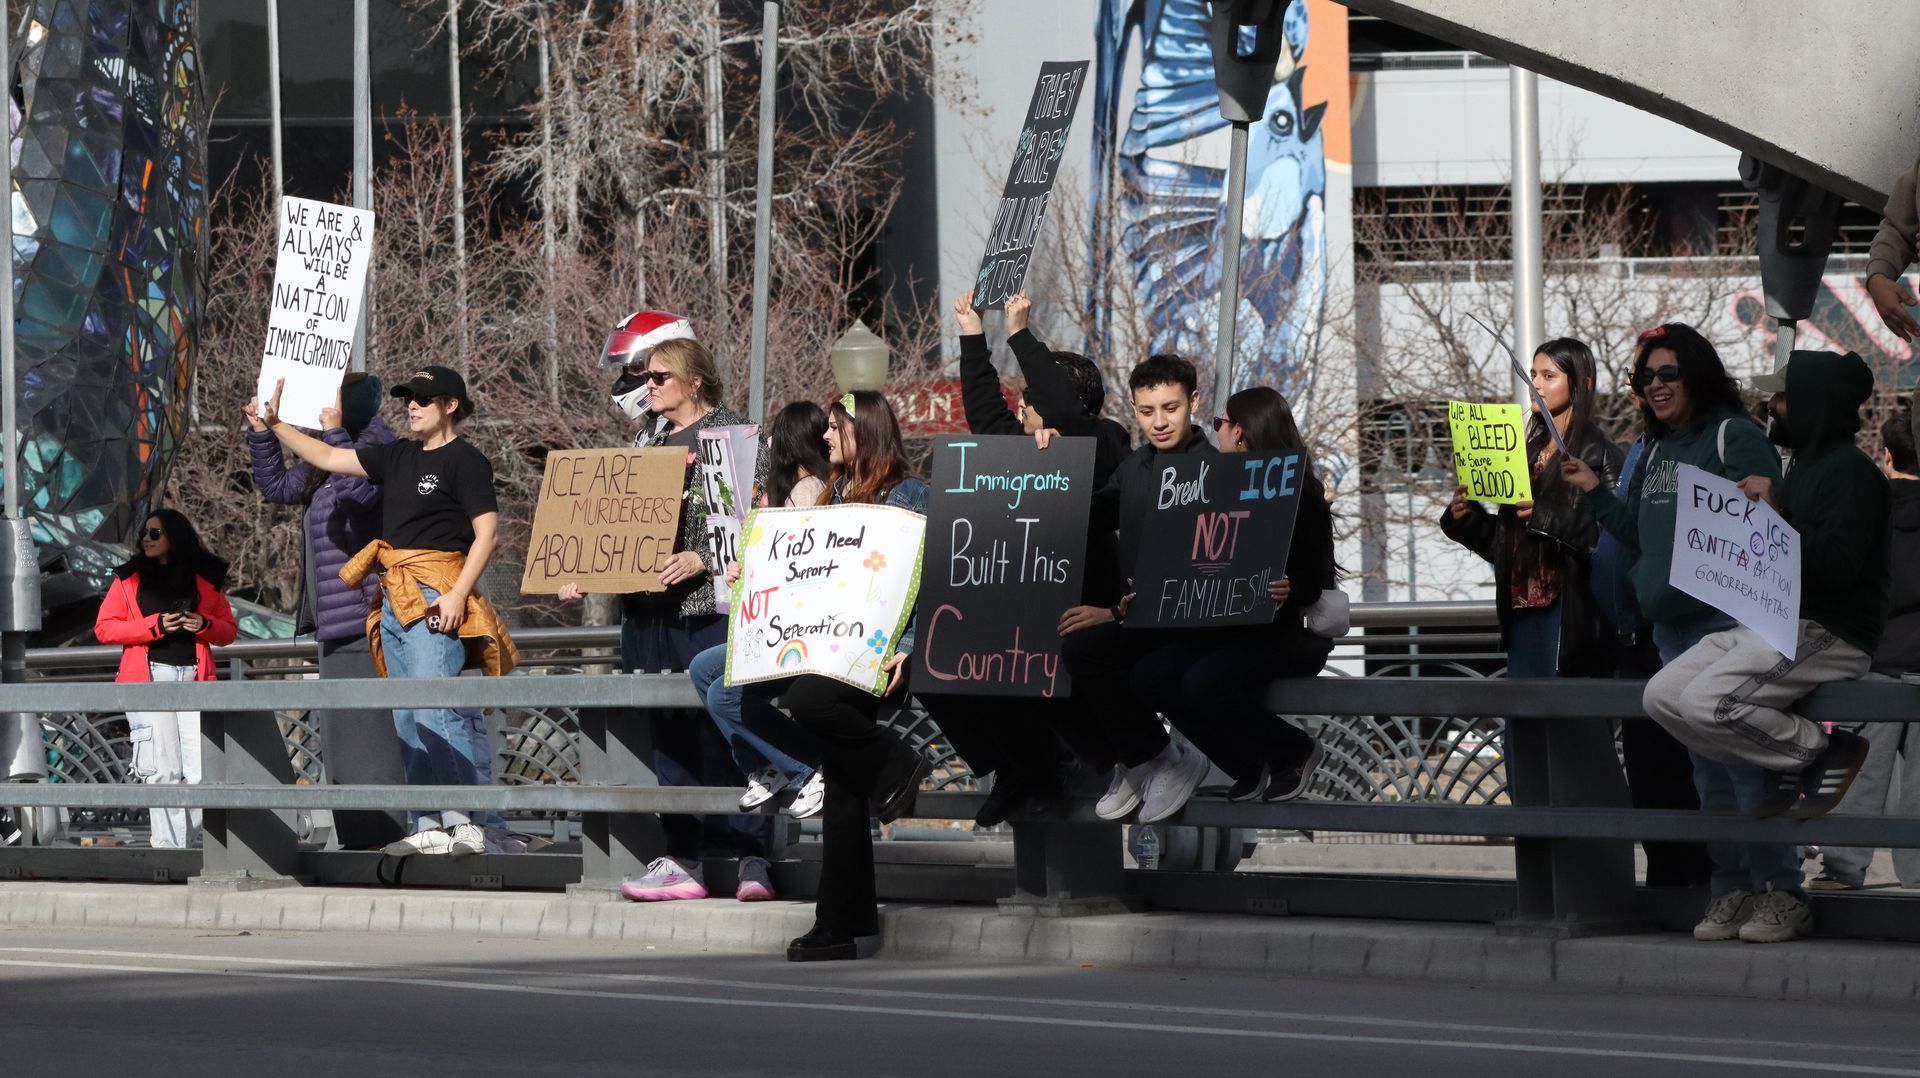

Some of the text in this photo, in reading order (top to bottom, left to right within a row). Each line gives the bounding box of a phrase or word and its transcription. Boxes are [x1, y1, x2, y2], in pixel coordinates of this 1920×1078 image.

[1034, 67, 1083, 120] THEY
[1015, 128, 1063, 185] ARE
[287, 201, 362, 241] WE ARE &
[985, 190, 1051, 257] KILLING
[282, 228, 352, 264] ALWAYS
[304, 257, 349, 280] WILL BE
[316, 275, 326, 291] A
[988, 253, 1028, 306] US
[275, 283, 349, 322] NATION
[306, 318, 319, 331] OF
[265, 326, 351, 370] IMMIGRANTS
[1469, 404, 1487, 421] ALL
[1467, 423, 1517, 452] BLEED
[546, 454, 642, 500] ICE ARE
[945, 442, 1070, 510] Immigrants
[1239, 454, 1299, 500] ICE
[1455, 452, 1466, 467] The
[1471, 469, 1514, 498] BLOOD
[571, 496, 675, 525] MURDERERS
[1693, 484, 1791, 556] FUCK ICE
[950, 518, 1070, 587] Built This
[1191, 510, 1251, 561] NOT
[528, 533, 671, 580] ABOLISH ICE
[785, 559, 840, 582] Support
[1753, 560, 1792, 597] AKTION
[740, 586, 779, 629] NOT
[766, 612, 864, 648] Seperation
[925, 604, 1059, 698] Country
